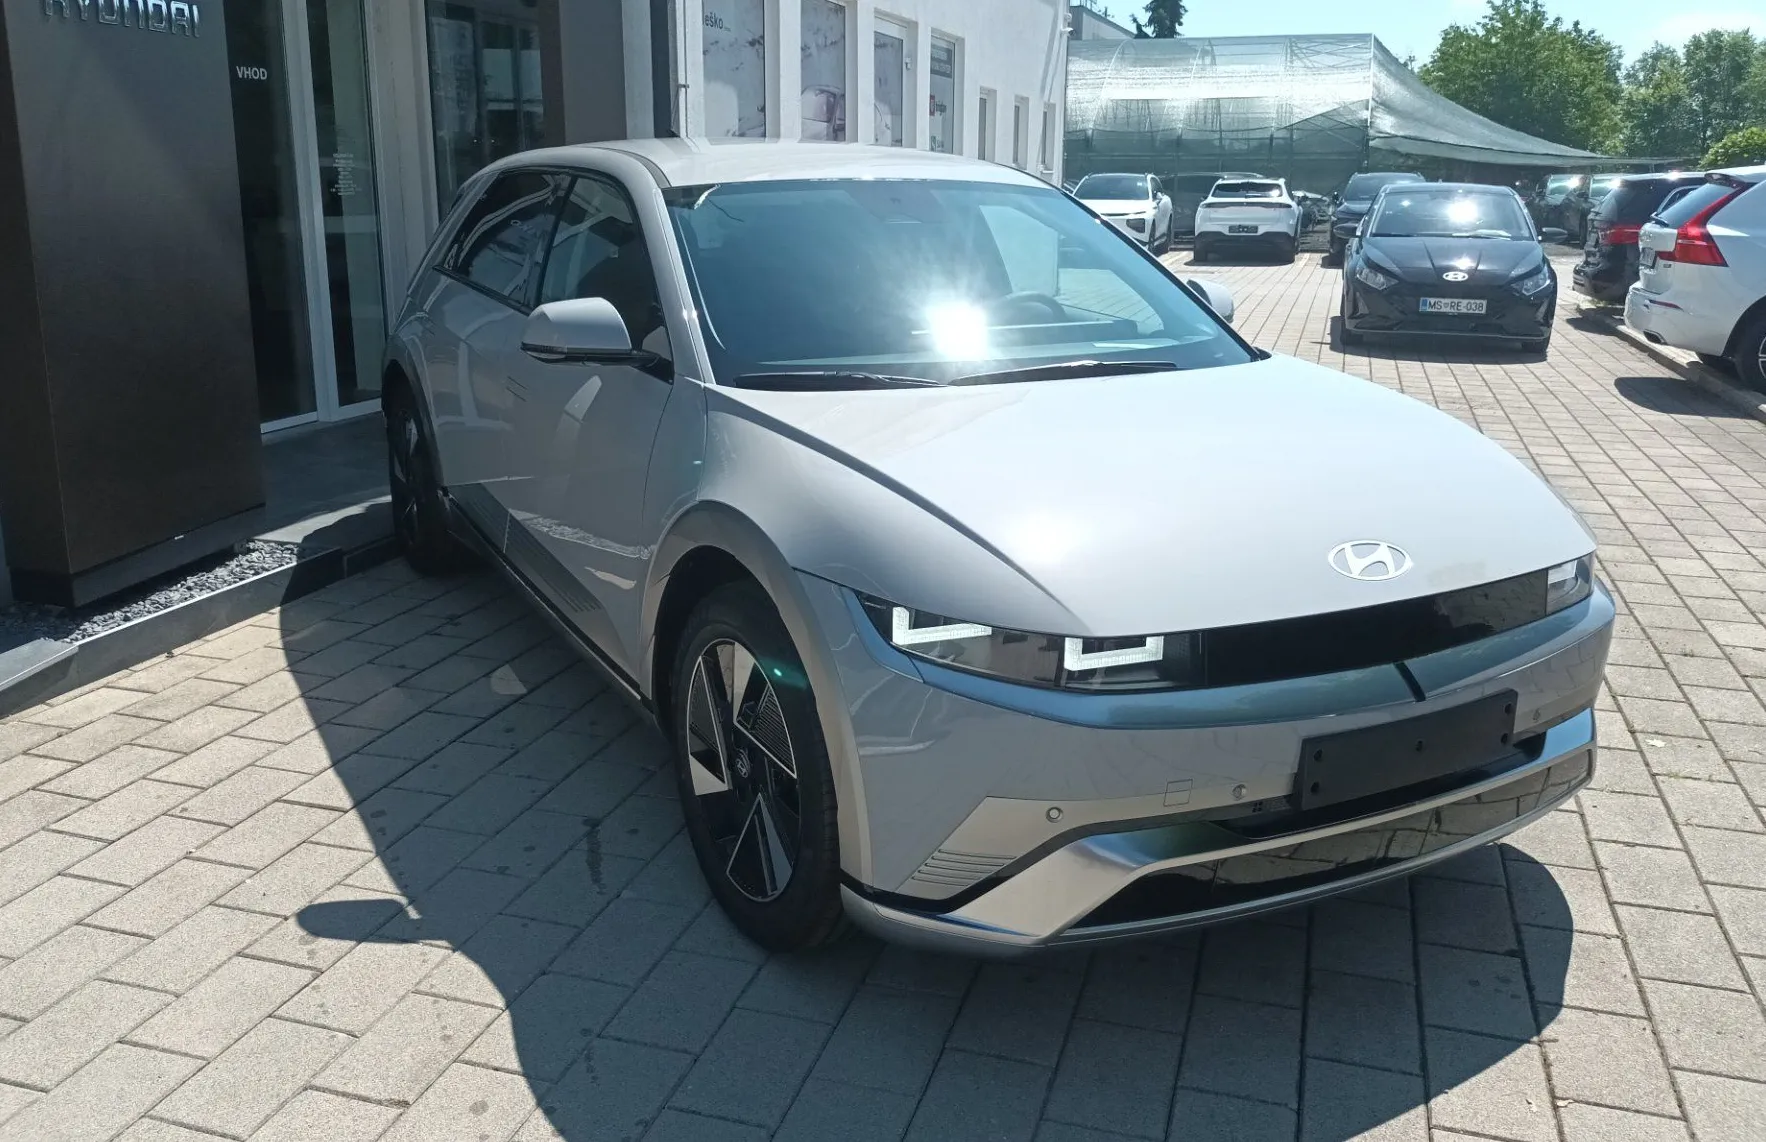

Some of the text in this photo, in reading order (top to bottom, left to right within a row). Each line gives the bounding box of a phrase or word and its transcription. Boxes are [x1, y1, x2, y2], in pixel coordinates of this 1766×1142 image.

[236, 65, 268, 80] VHOD
[1428, 300, 1484, 312] MS RE-038
